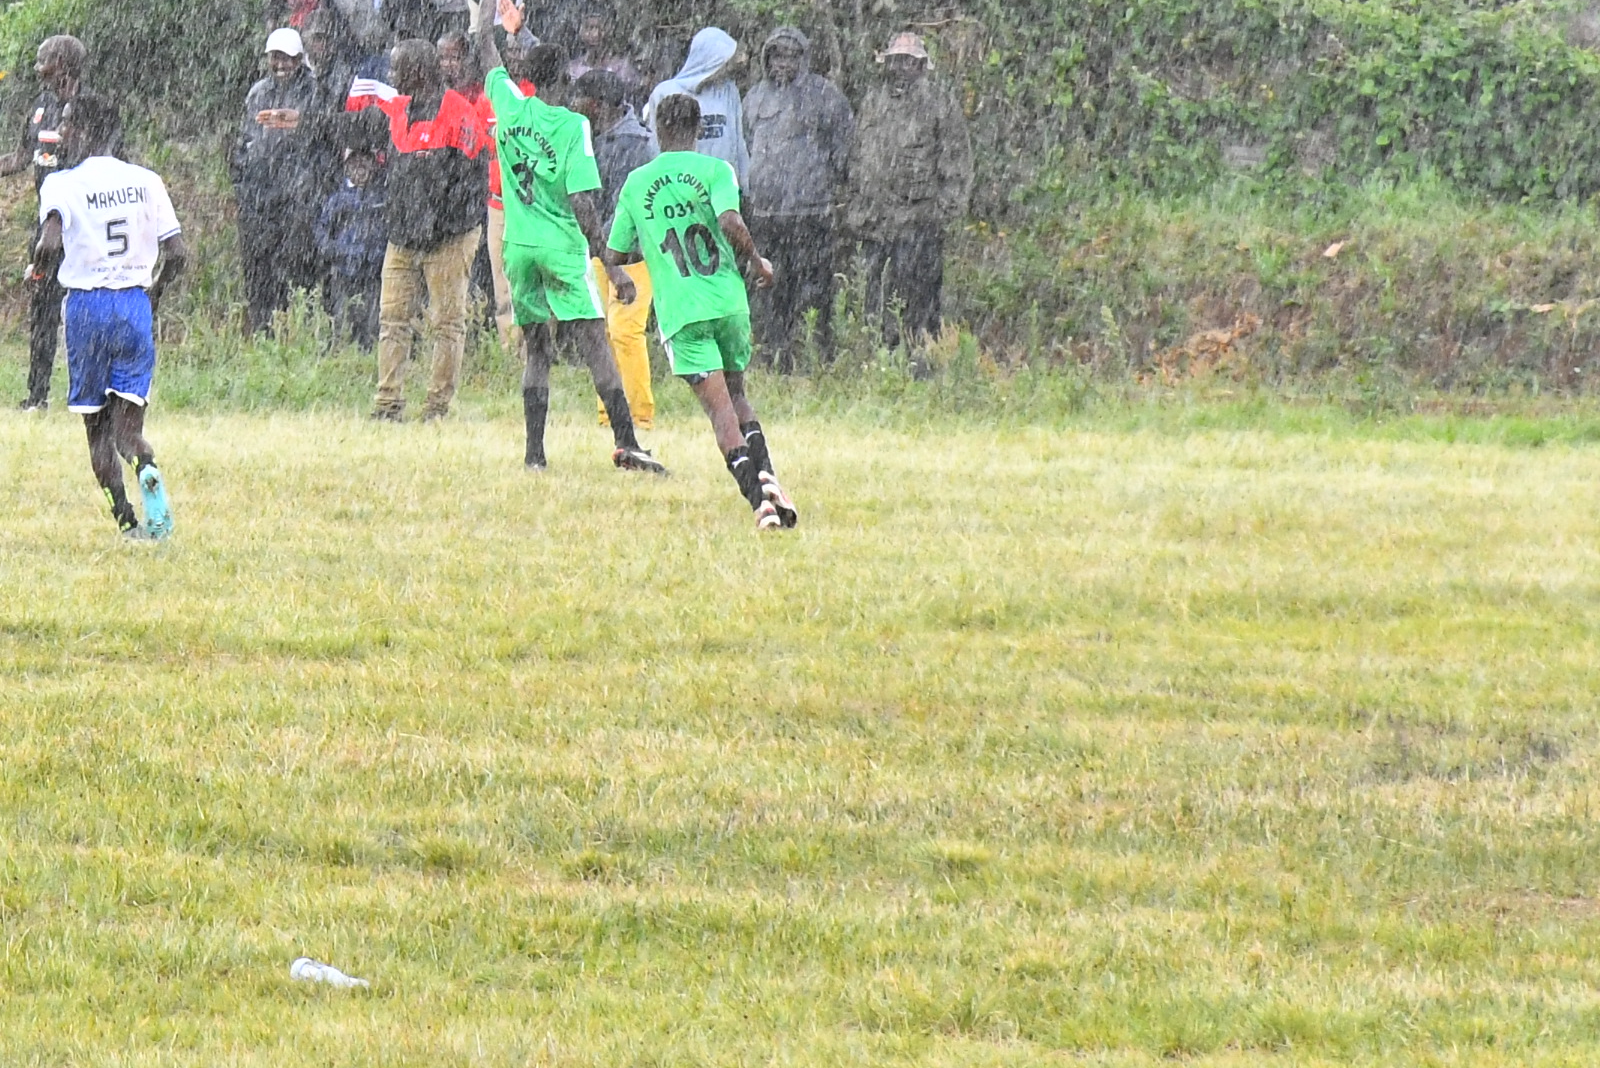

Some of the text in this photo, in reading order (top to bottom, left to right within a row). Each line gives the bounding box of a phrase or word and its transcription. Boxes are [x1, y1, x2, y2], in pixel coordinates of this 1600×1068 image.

[533, 131, 557, 175] COUNTY
[86, 186, 148, 210] MAKUENI
[643, 172, 712, 221] LAIKIPIA COUNTY
[663, 200, 696, 220] 031
[105, 217, 130, 259] 5
[659, 223, 720, 278] 10
